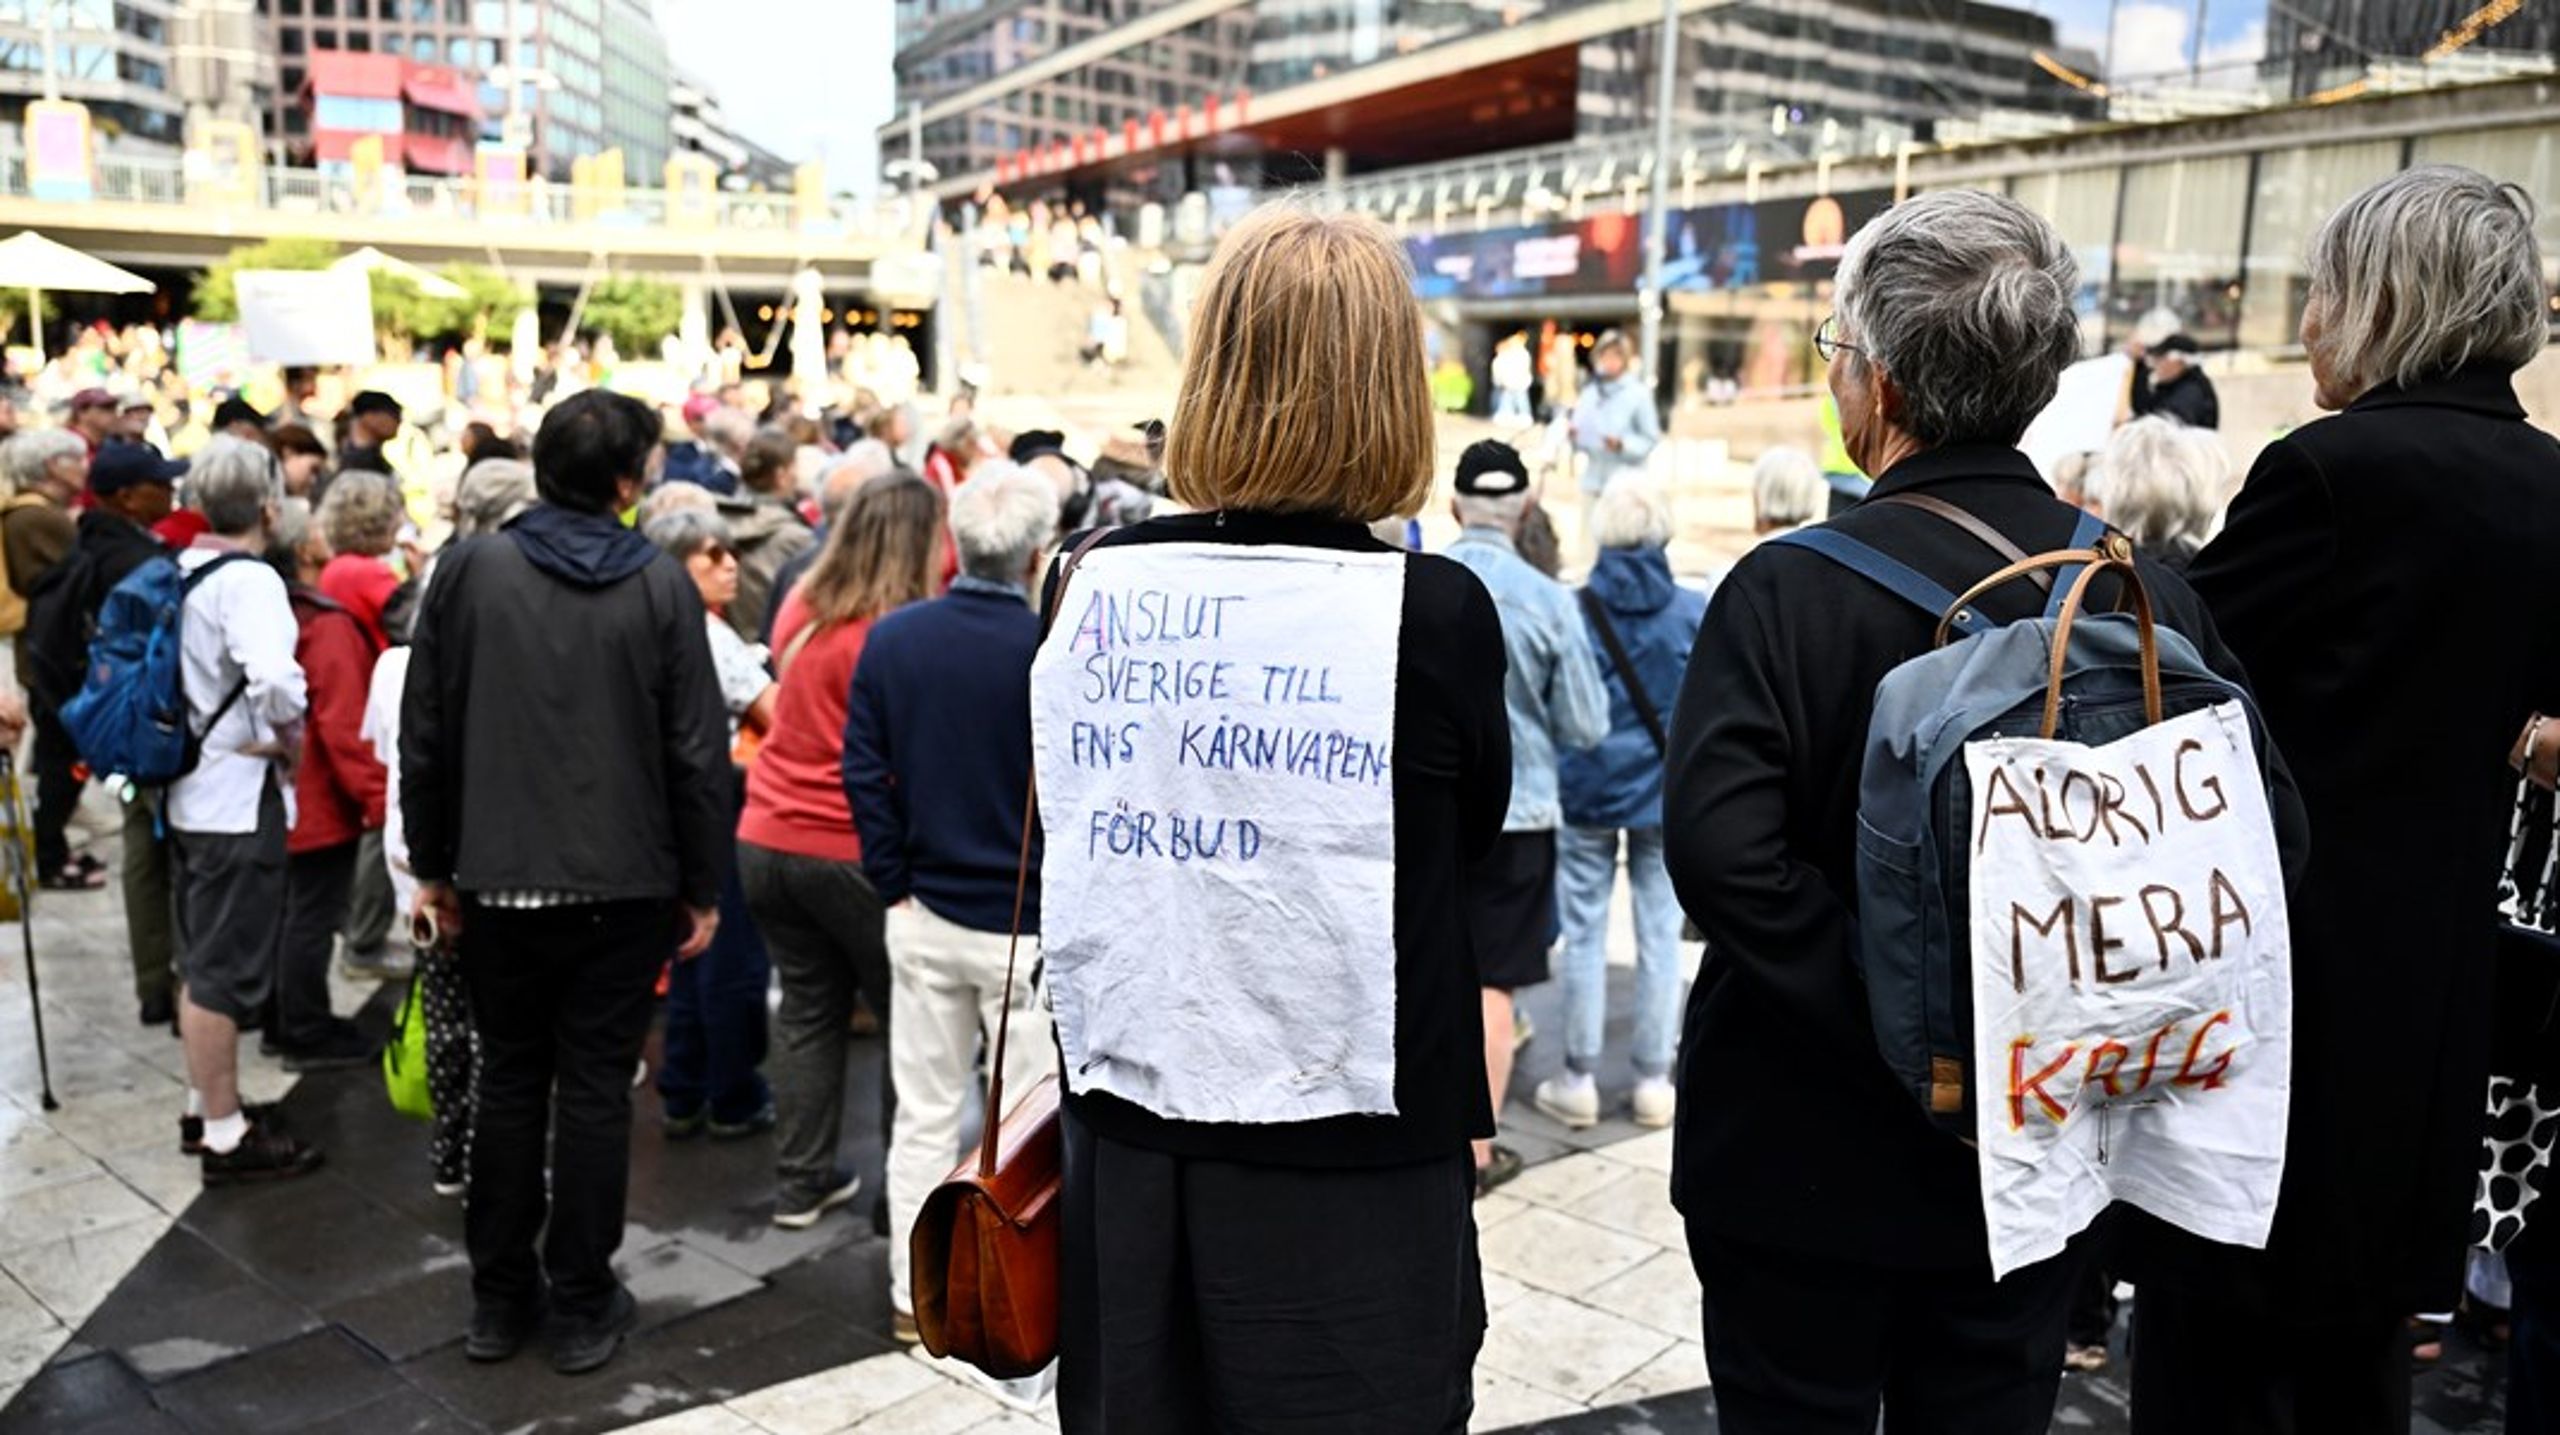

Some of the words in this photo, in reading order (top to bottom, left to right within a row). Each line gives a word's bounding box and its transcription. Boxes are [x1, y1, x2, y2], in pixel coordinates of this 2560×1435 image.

[1069, 590, 1244, 653] ANSLUT
[1083, 652, 1233, 705] SVERIGE
[1263, 665, 1342, 704] TILL
[1089, 798, 1262, 862] FÖRBUD
[2011, 867, 2251, 993] MERA
[2008, 1011, 2236, 1130] KRIG
